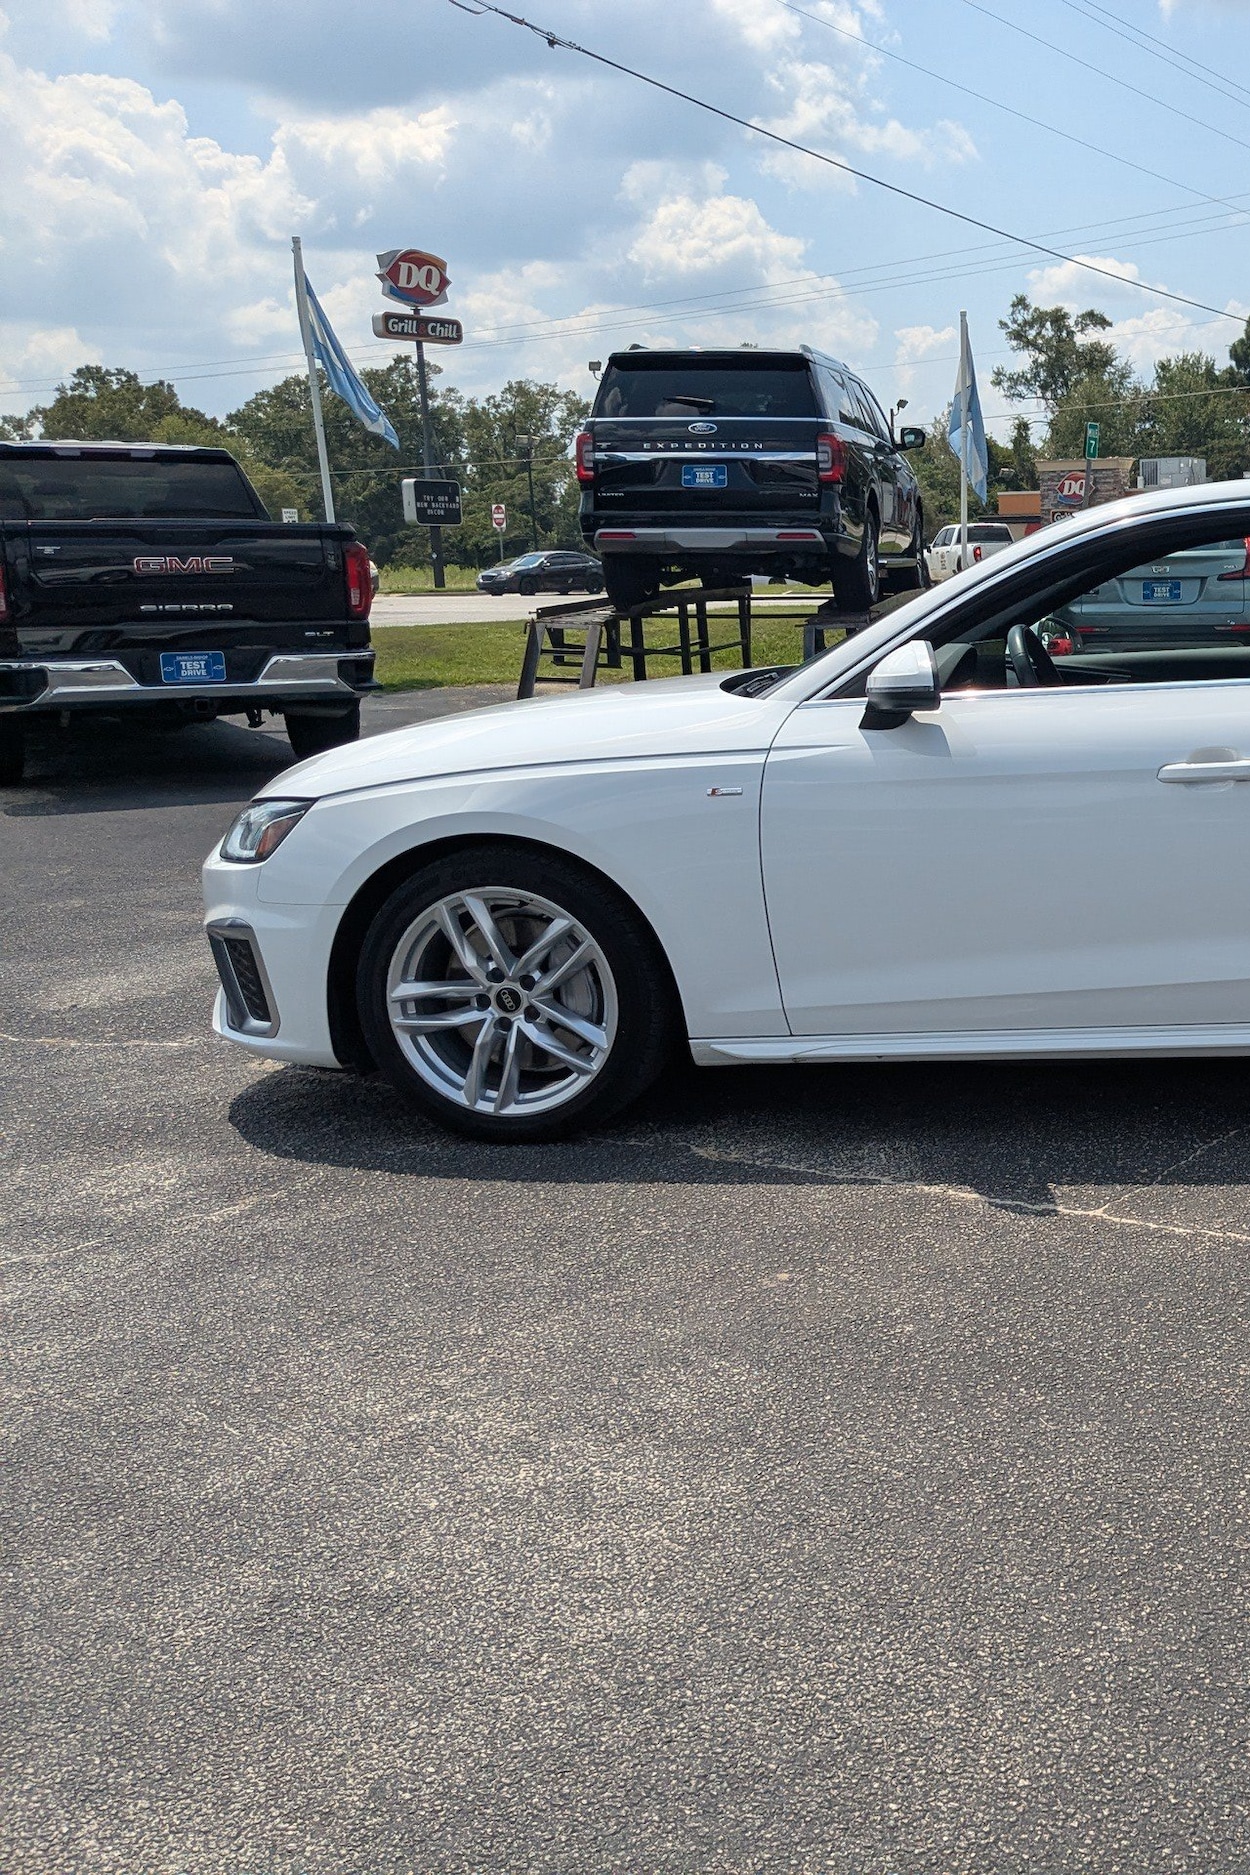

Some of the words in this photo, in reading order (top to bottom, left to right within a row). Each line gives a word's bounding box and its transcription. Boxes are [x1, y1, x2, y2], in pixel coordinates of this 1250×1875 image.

[397, 261, 441, 296] DQ
[387, 318, 418, 334] Grill
[427, 322, 458, 339] Chill
[643, 442, 764, 450] EXPEDITION
[1089, 440, 1096, 454] 7
[695, 471, 714, 479] TEST
[134, 556, 234, 574] GMC
[180, 660, 206, 670] TEST
[180, 669, 208, 678] DRIVE
